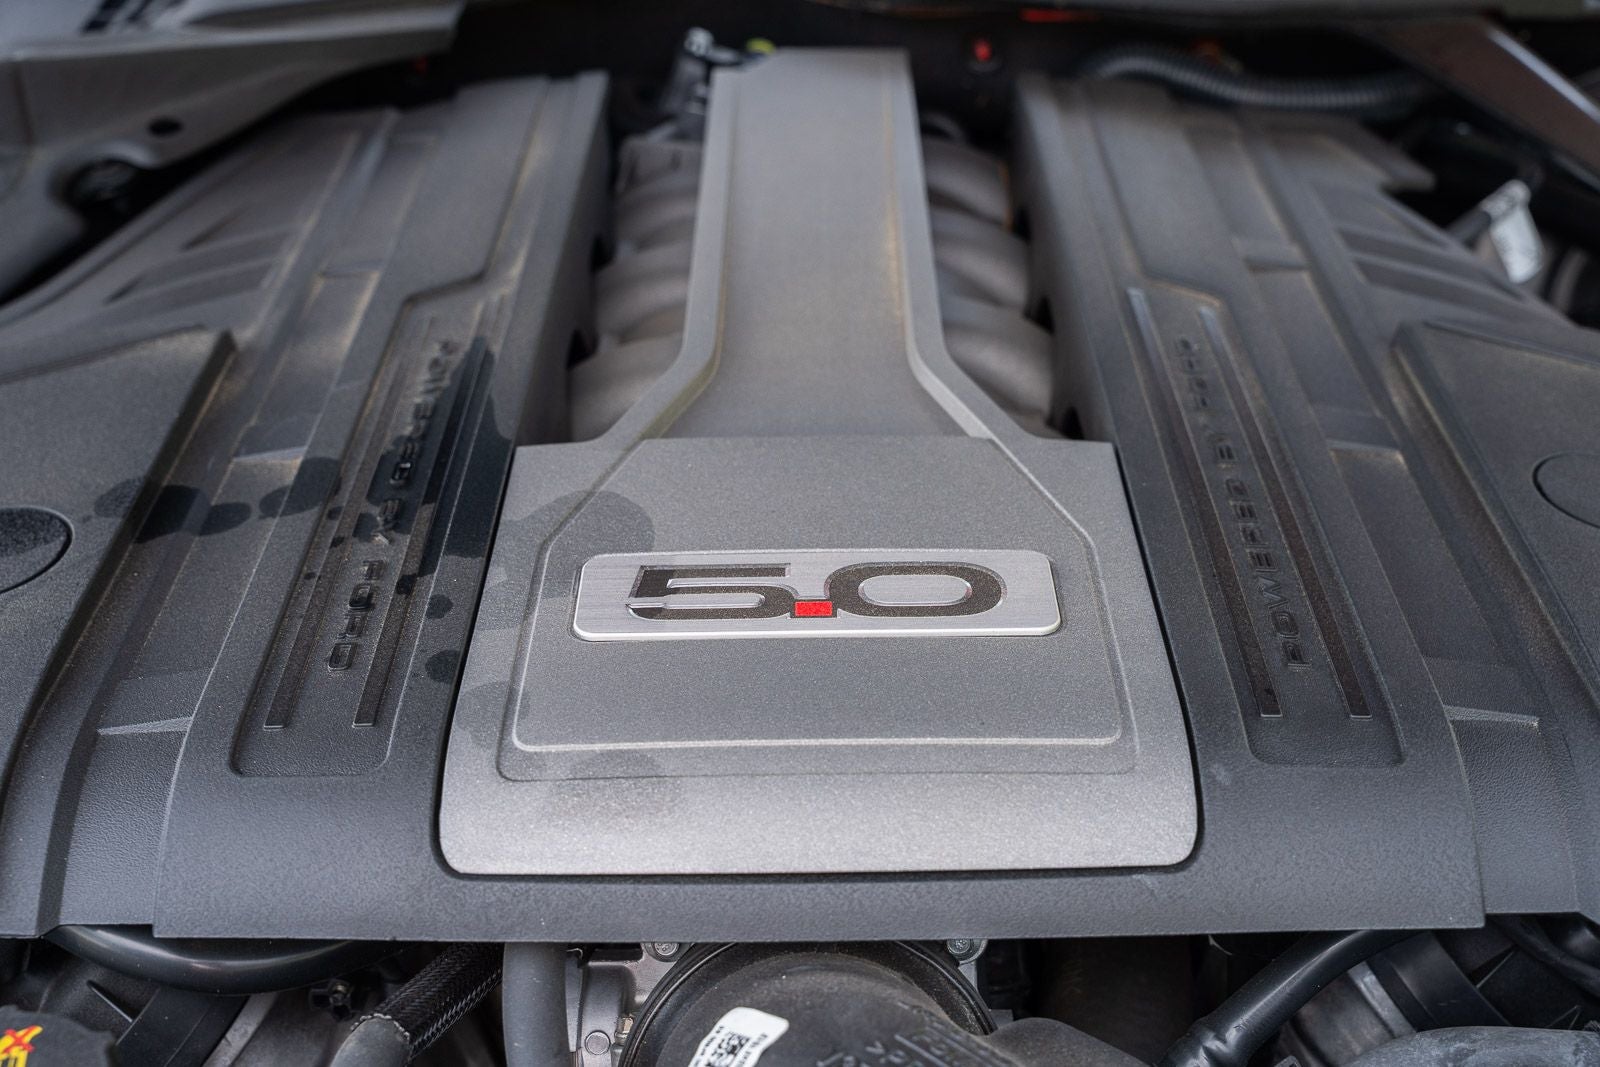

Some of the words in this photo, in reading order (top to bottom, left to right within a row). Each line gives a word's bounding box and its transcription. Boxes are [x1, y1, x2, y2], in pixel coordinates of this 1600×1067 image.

[328, 560, 386, 671] FORD
[626, 562, 1007, 620] 5.0
[1226, 477, 1312, 672] POWERED
